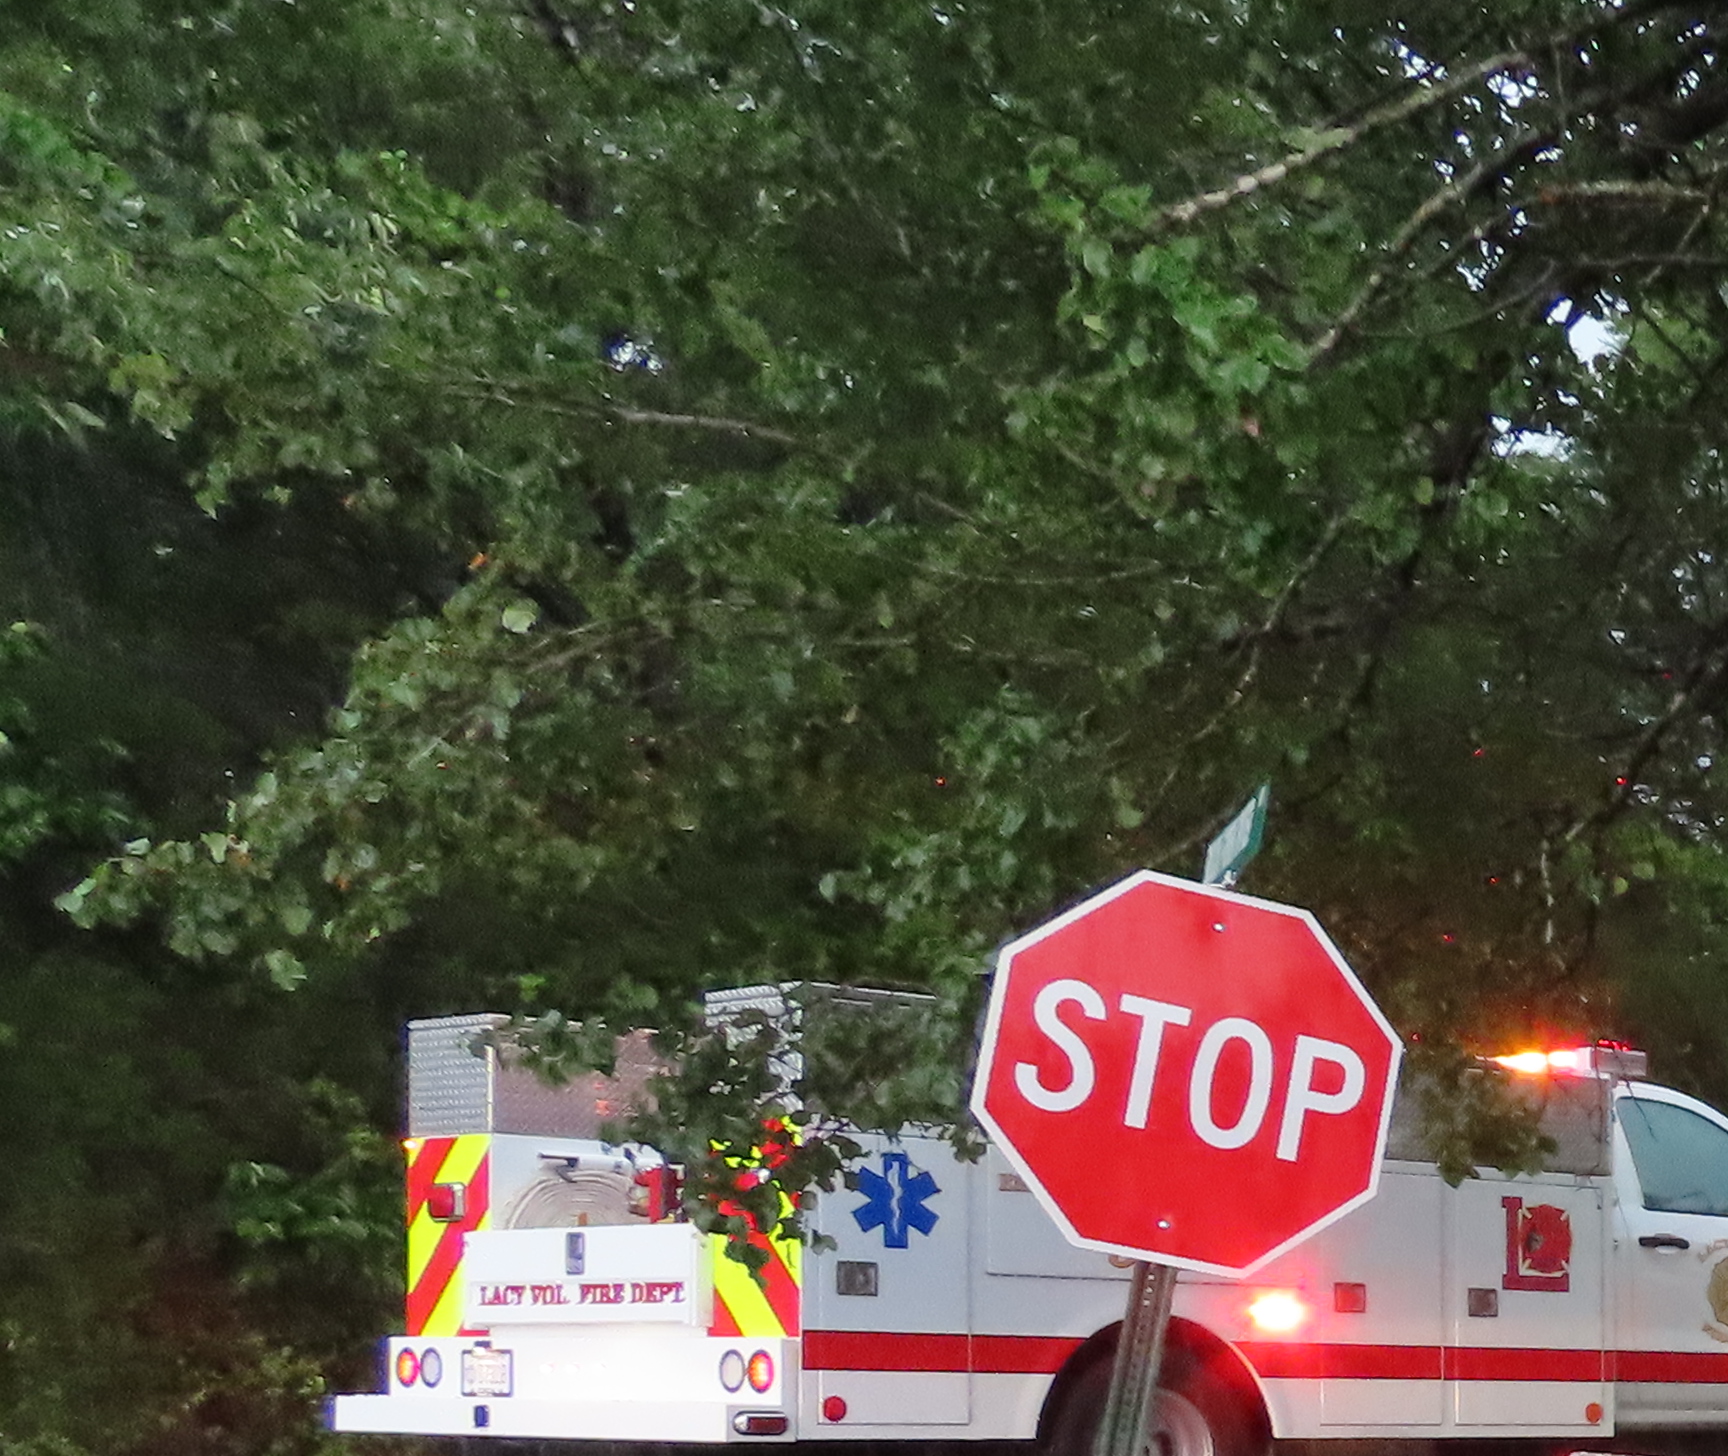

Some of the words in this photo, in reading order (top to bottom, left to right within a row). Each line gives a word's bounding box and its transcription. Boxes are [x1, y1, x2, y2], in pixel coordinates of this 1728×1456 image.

[1014, 979, 1366, 1163] STOP
[478, 1285, 527, 1306] LACY
[576, 1283, 625, 1304] FIRE
